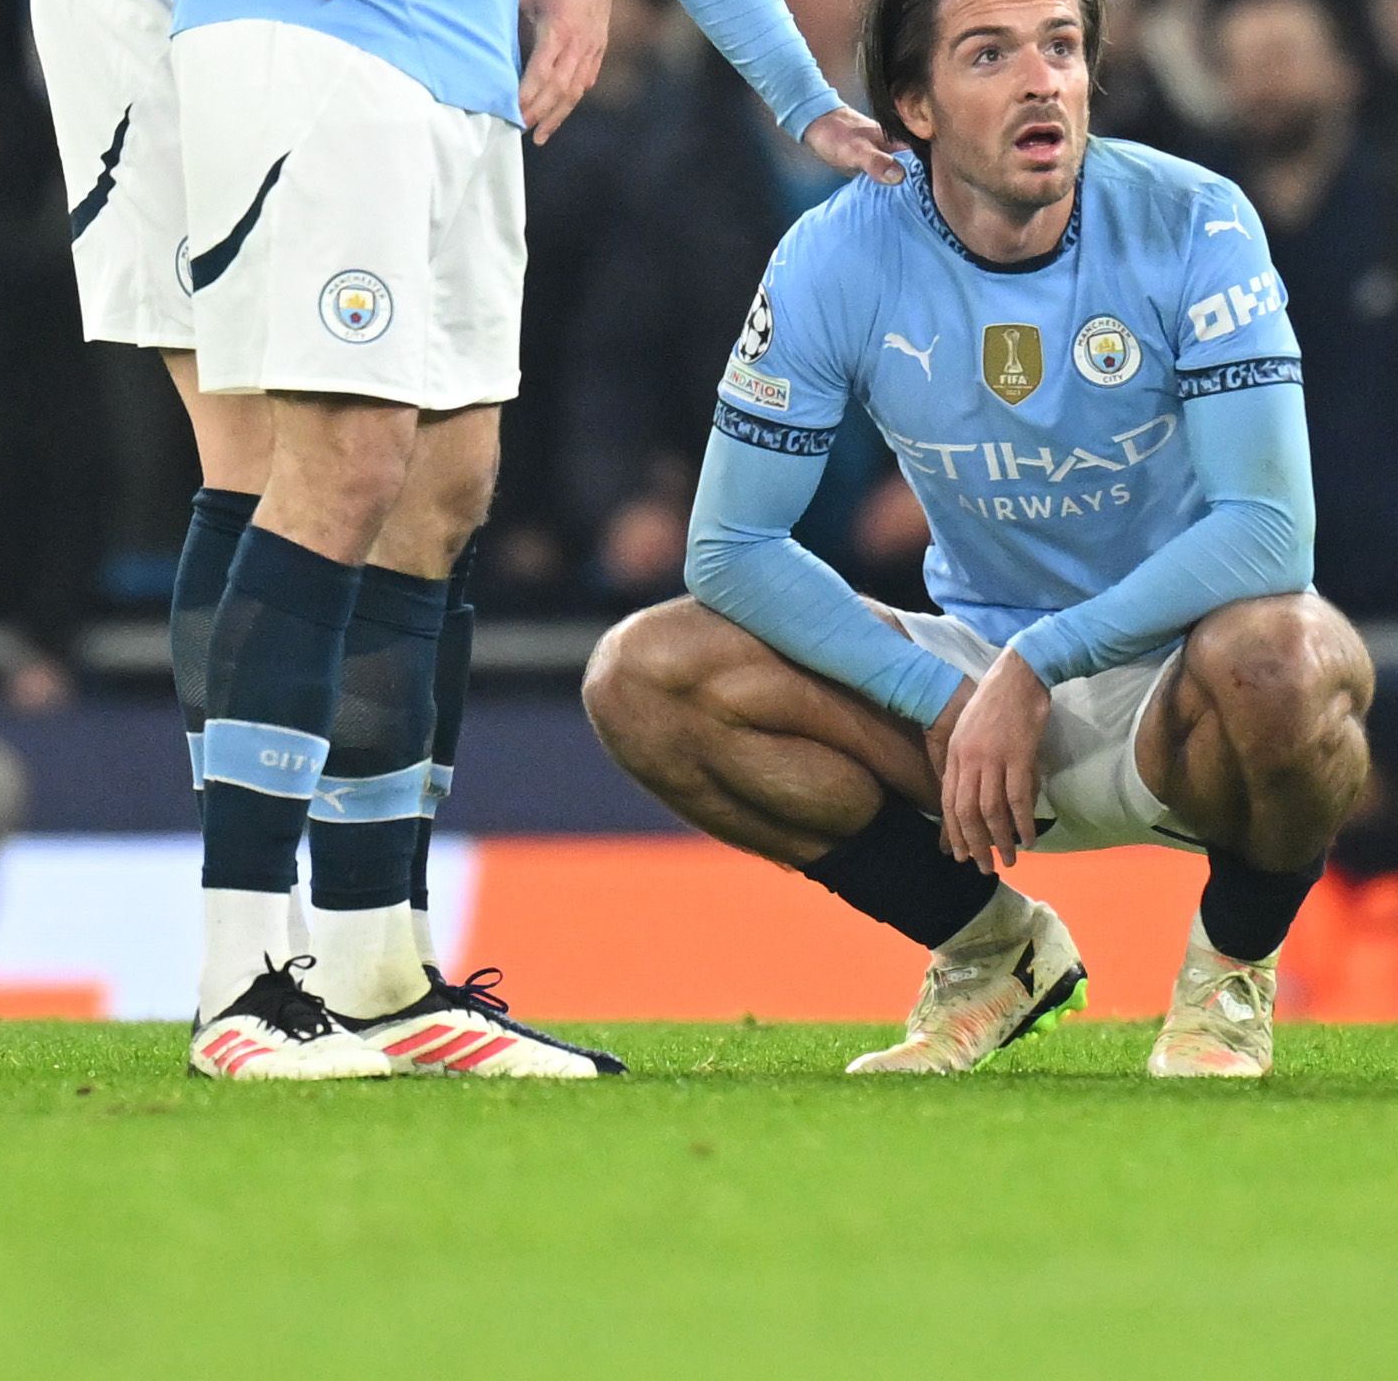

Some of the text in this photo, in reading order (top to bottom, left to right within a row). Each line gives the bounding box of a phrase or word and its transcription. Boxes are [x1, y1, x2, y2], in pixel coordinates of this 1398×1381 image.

[1077, 319, 1131, 347] MANCHESTER
[999, 374, 1028, 385] FIFA
[1102, 375, 1123, 384] CITY
[890, 413, 1177, 483] ETIHAD
[958, 483, 1131, 521] AIRWAYS
